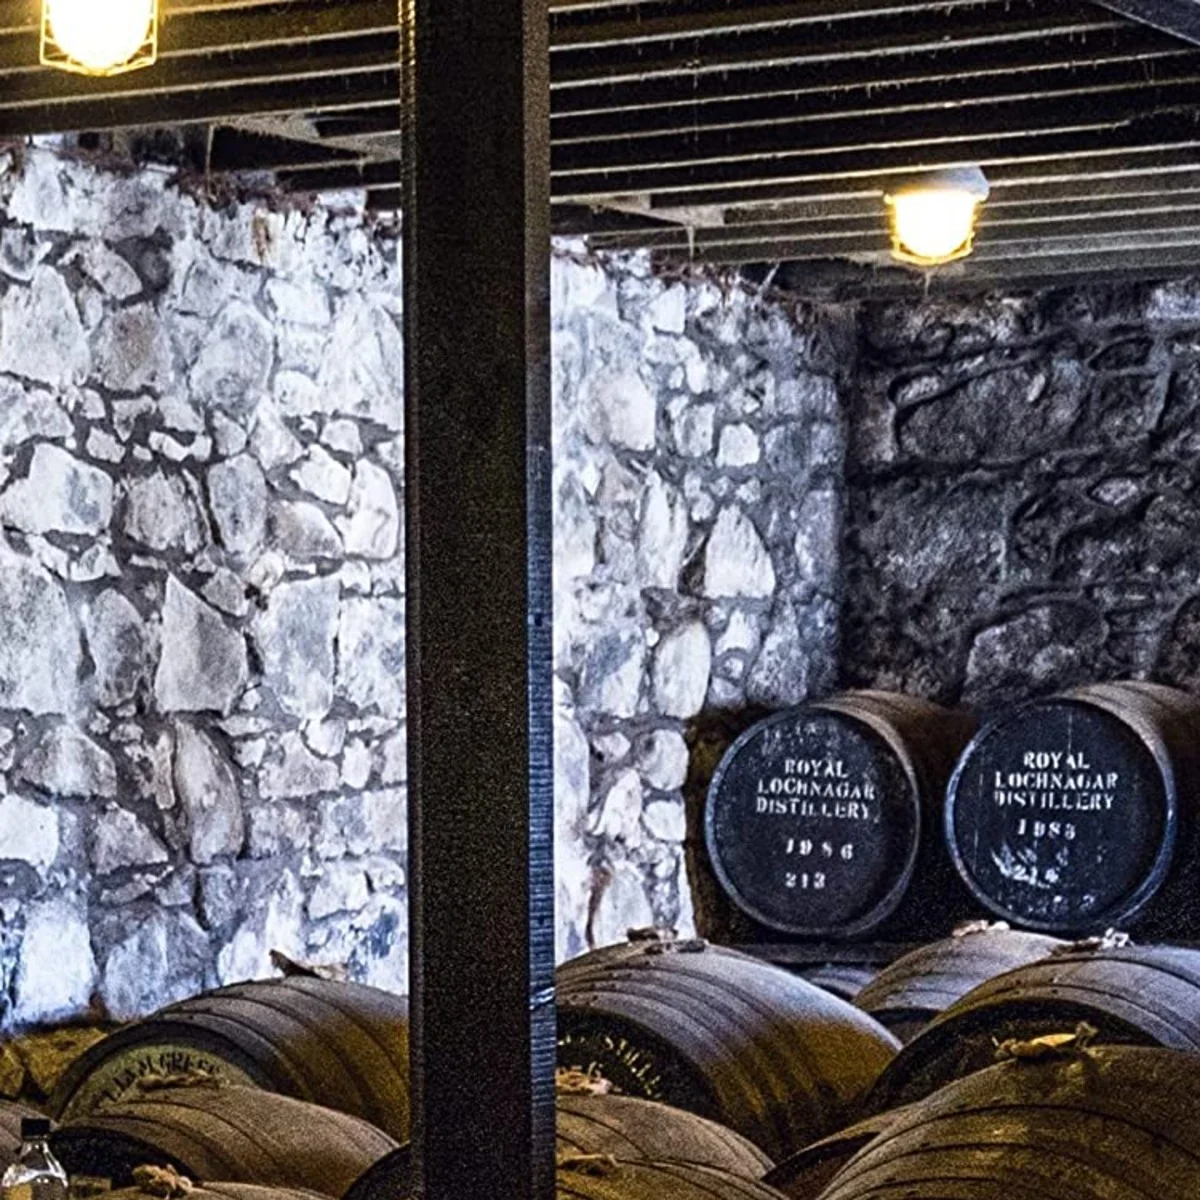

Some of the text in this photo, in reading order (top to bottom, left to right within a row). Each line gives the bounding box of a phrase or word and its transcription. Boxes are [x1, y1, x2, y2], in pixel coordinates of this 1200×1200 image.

[785, 758, 849, 779] ROYAL
[1024, 751, 1091, 770] ROYAL
[757, 777, 876, 801] LOCHNAGAR
[994, 771, 1118, 790] LOCHNAGAR
[756, 796, 870, 820] DISTILLERY
[994, 790, 1115, 811] DISTILLERY
